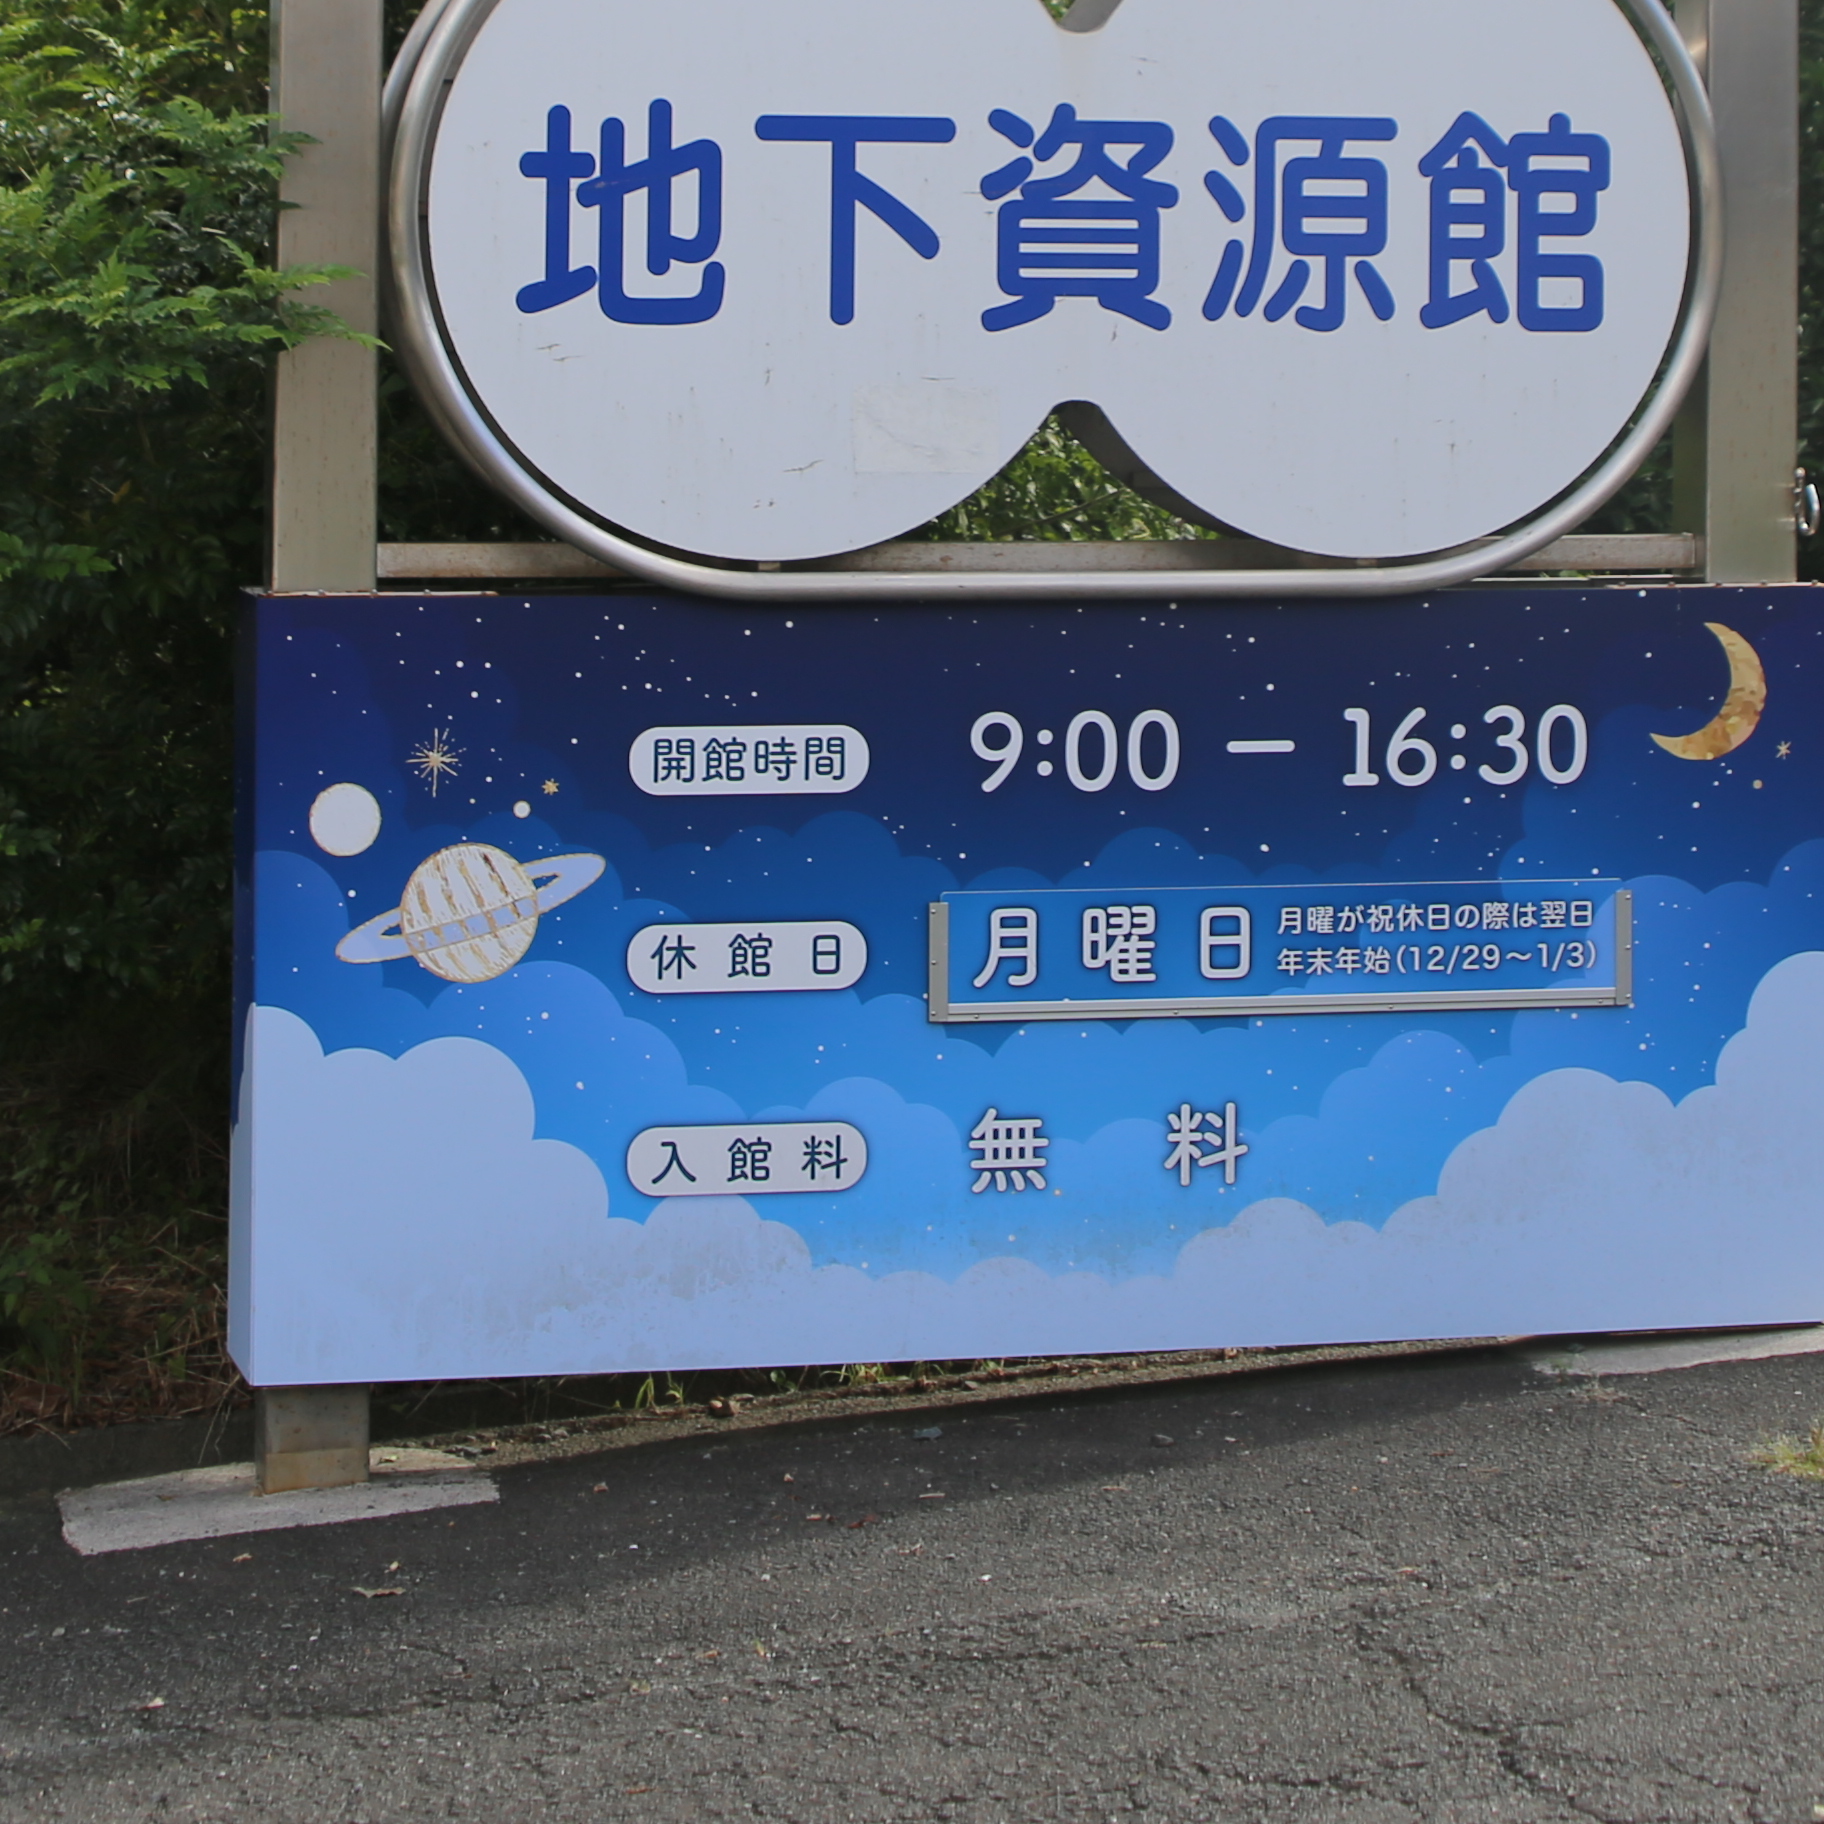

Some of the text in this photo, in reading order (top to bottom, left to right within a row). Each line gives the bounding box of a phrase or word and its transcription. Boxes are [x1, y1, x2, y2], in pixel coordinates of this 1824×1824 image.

[515, 97, 1612, 332] 地下資源館
[653, 736, 847, 784] 開館時間
[970, 709, 1180, 793] 9:00
[1342, 704, 1588, 788] 16:30
[1277, 900, 1594, 936] 月曜が祝休日の際は翌日
[650, 932, 843, 981] 休館日
[974, 906, 1251, 988] 月曜日
[651, 1133, 848, 1185] 入館料
